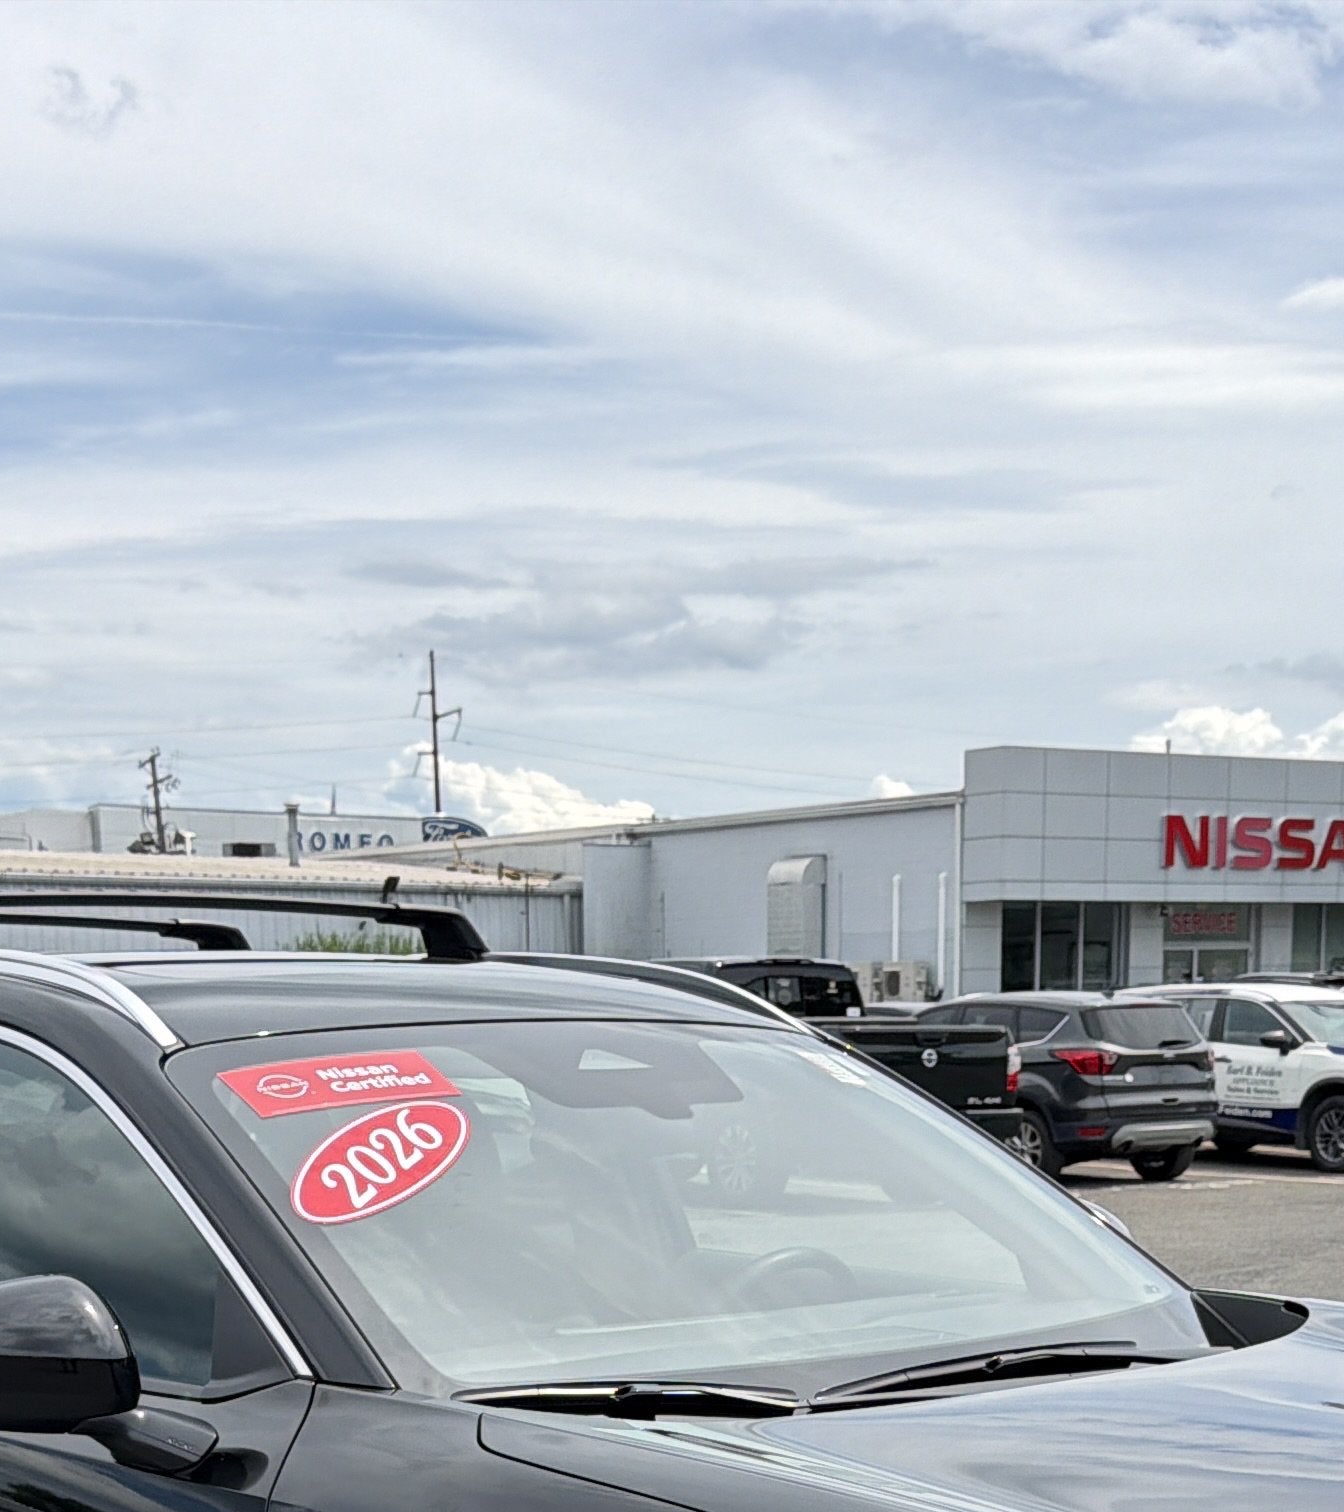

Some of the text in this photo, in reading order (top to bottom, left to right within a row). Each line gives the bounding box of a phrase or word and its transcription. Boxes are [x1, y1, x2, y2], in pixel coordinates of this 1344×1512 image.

[1171, 912, 1237, 934] SERVICE
[315, 1062, 398, 1081] Nissan
[256, 1080, 309, 1093] NISSAN
[330, 1072, 433, 1093] Certified
[321, 1109, 443, 1209] 2026
